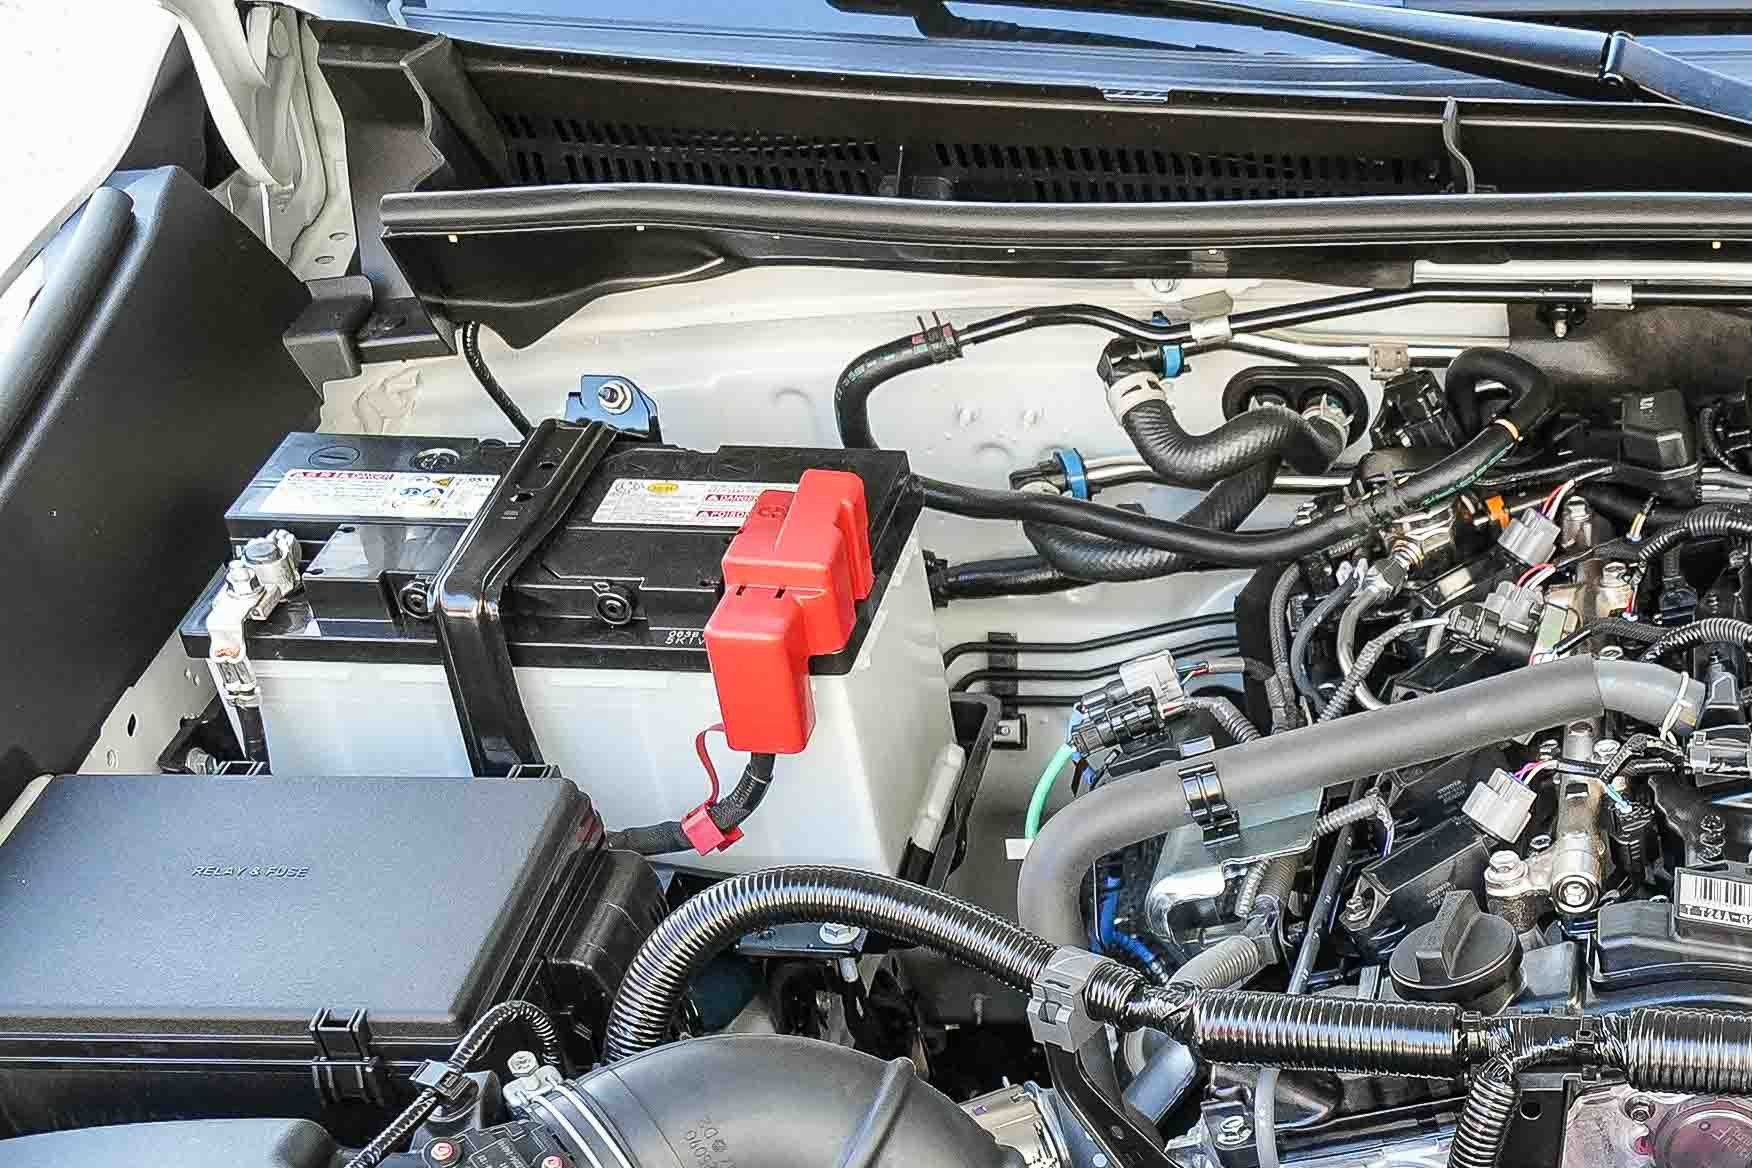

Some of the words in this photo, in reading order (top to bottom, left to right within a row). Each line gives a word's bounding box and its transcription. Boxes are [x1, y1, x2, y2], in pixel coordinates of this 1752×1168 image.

[191, 864, 248, 878] RELAY
[248, 865, 261, 878] &
[263, 864, 310, 878] FUSE
